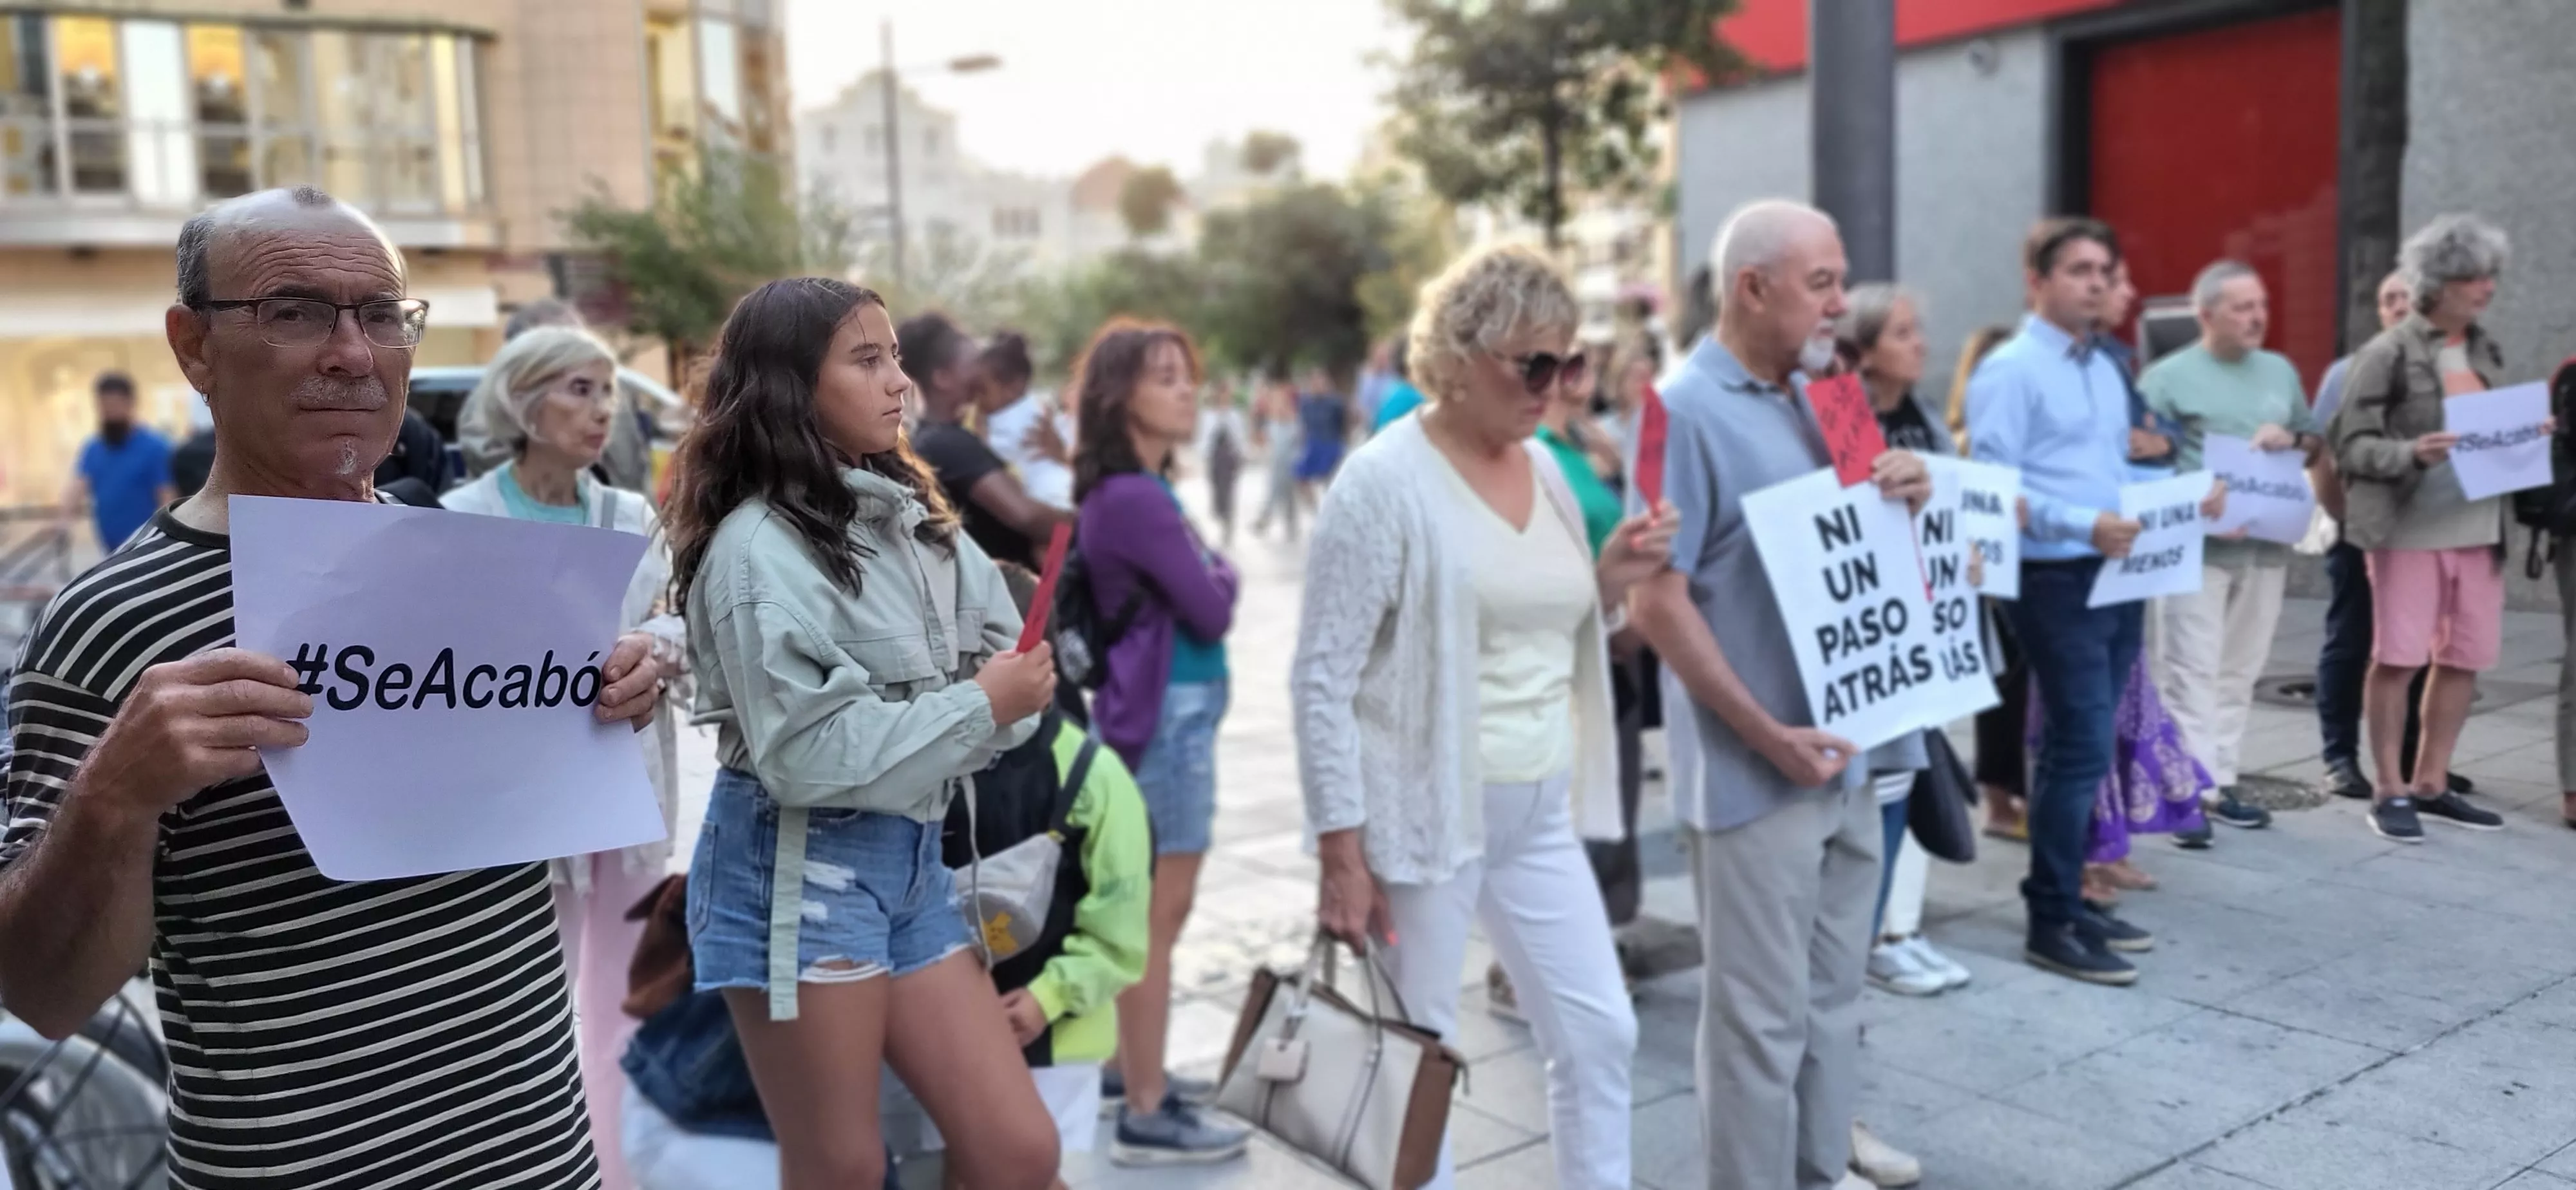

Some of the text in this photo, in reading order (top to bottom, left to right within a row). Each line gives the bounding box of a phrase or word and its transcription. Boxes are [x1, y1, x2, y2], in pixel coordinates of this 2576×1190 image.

[1814, 503, 1862, 552] NI
[1922, 509, 1954, 546] NI
[2160, 501, 2195, 529] UNA
[1822, 552, 1880, 603] UN
[2120, 544, 2185, 574] MENOS
[1815, 598, 1908, 666] PASO
[1933, 597, 1967, 634] SO
[286, 643, 603, 711] #SeAcabó
[1824, 643, 1933, 724] ATRÁS
